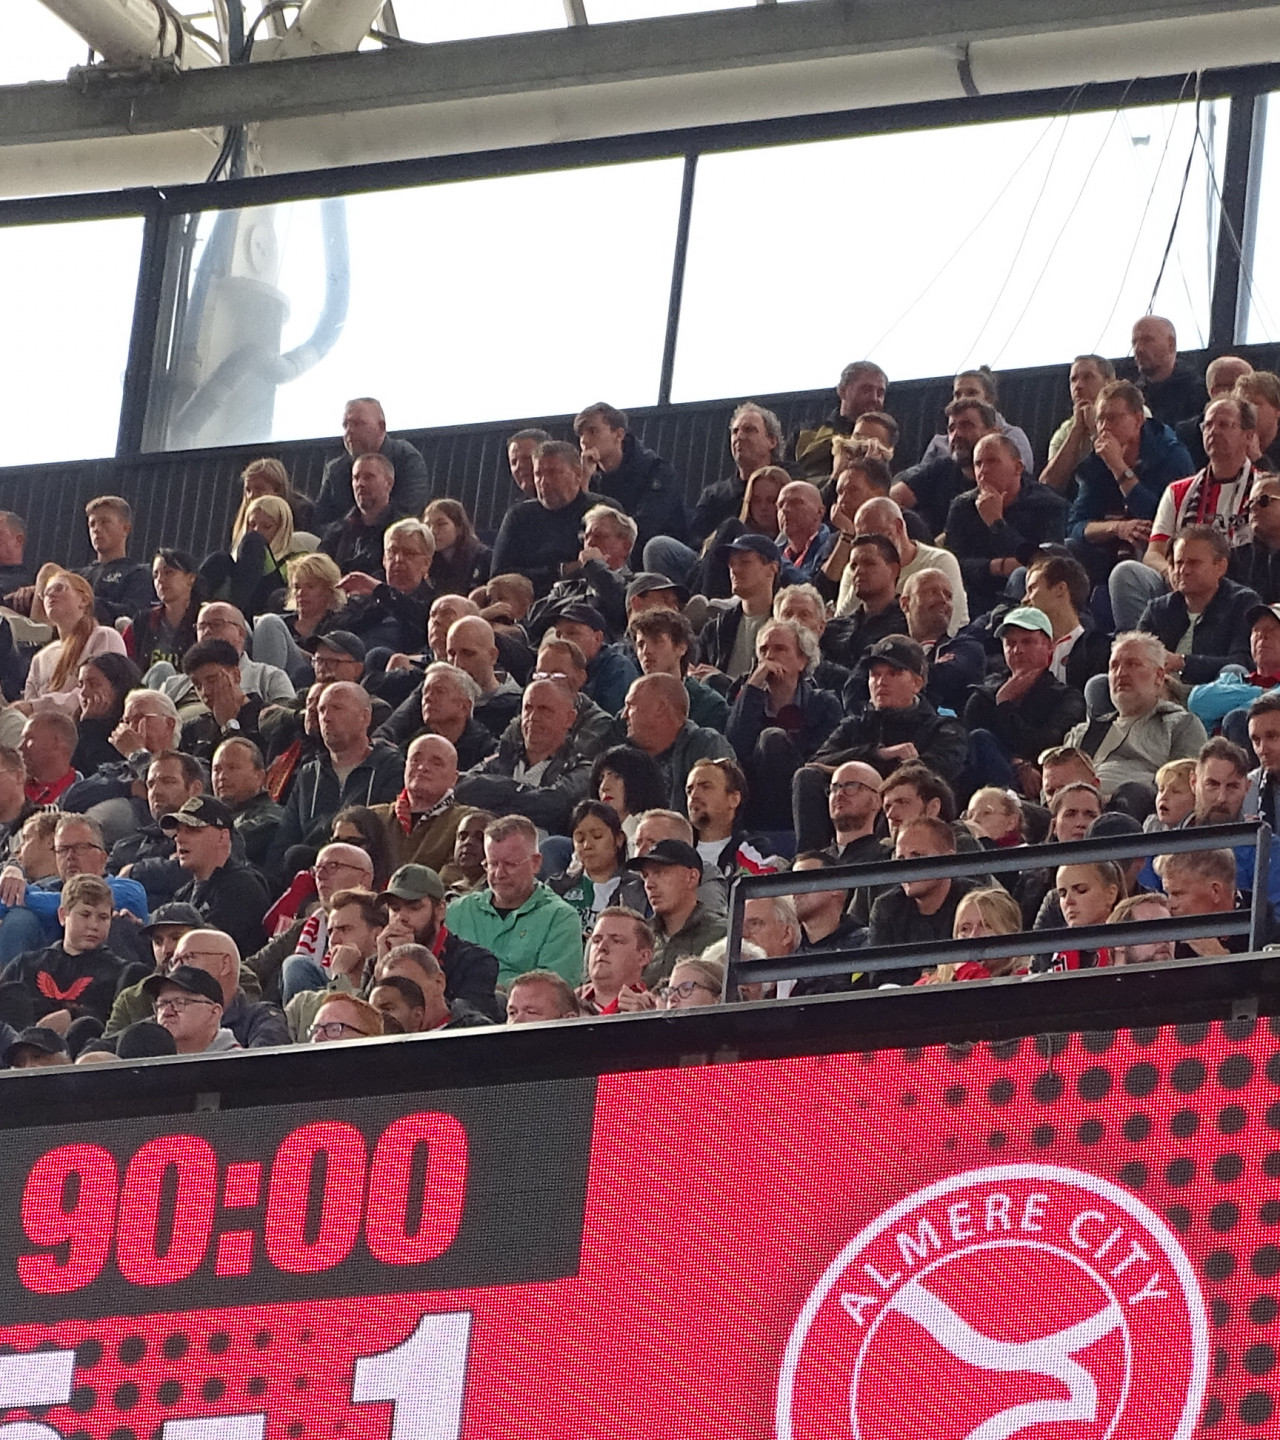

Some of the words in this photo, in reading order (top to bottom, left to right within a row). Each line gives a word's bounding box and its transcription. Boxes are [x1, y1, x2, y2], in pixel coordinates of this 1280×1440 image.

[18, 1111, 469, 1294] 90:00
[840, 1193, 1049, 1326] ALMERE
[1068, 1210, 1169, 1306] CITY
